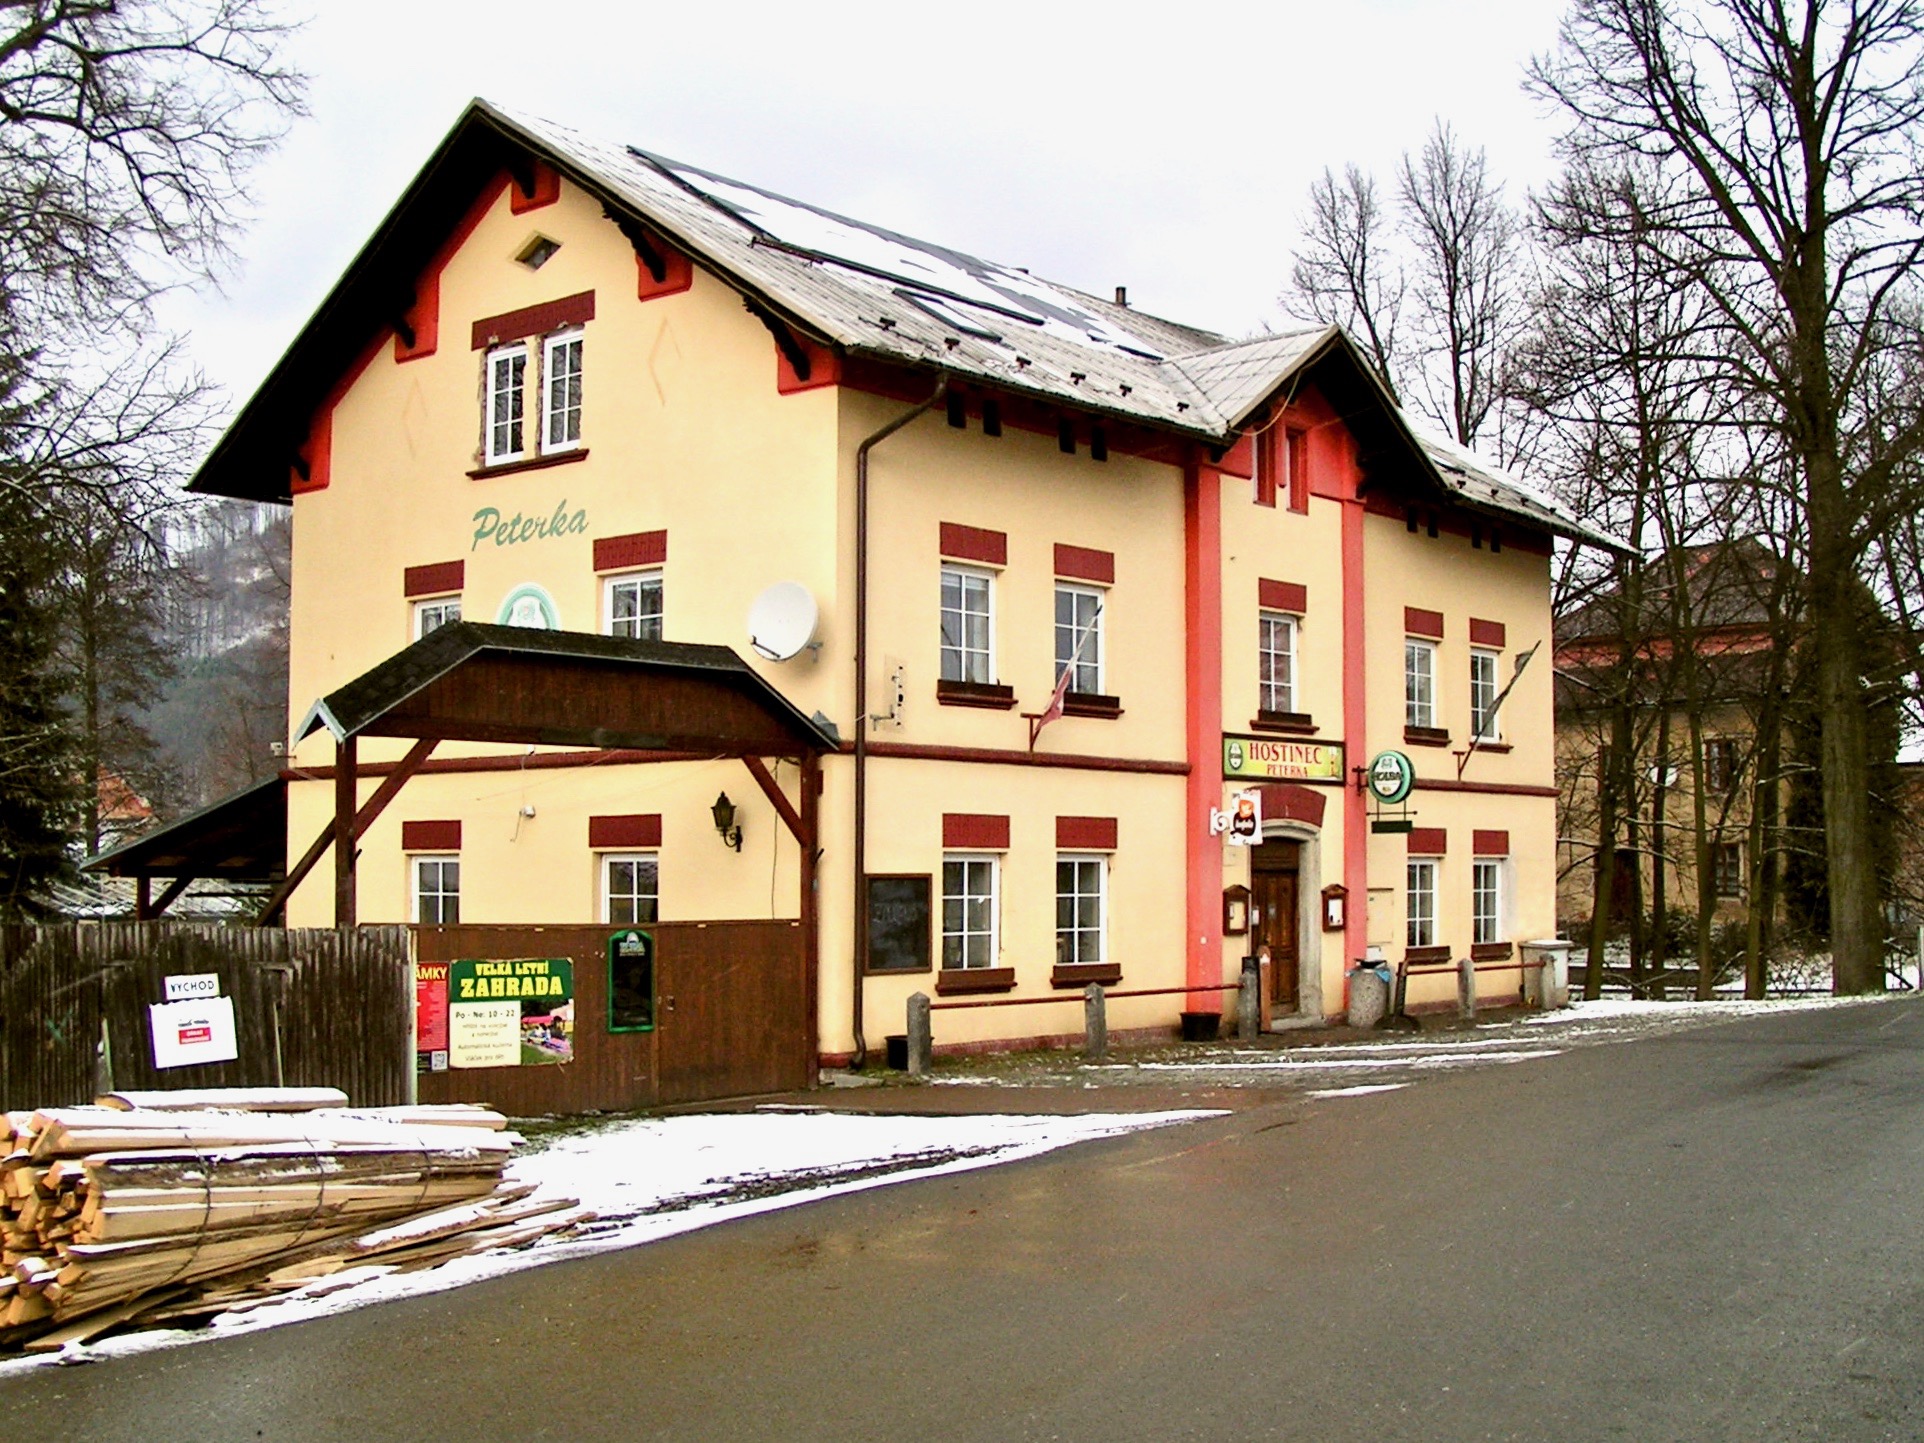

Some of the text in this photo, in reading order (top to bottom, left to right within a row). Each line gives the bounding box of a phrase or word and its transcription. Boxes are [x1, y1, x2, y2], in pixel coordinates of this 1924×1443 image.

[472, 498, 589, 551] Peterka
[1249, 742, 1322, 765] HOSTINEC
[475, 959, 549, 976] VELKÁ LETNÍ
[460, 976, 563, 998] ZAHRADA
[455, 1011, 466, 1019] Po
[488, 1010, 498, 1018] 10
[505, 1009, 515, 1017] 22
